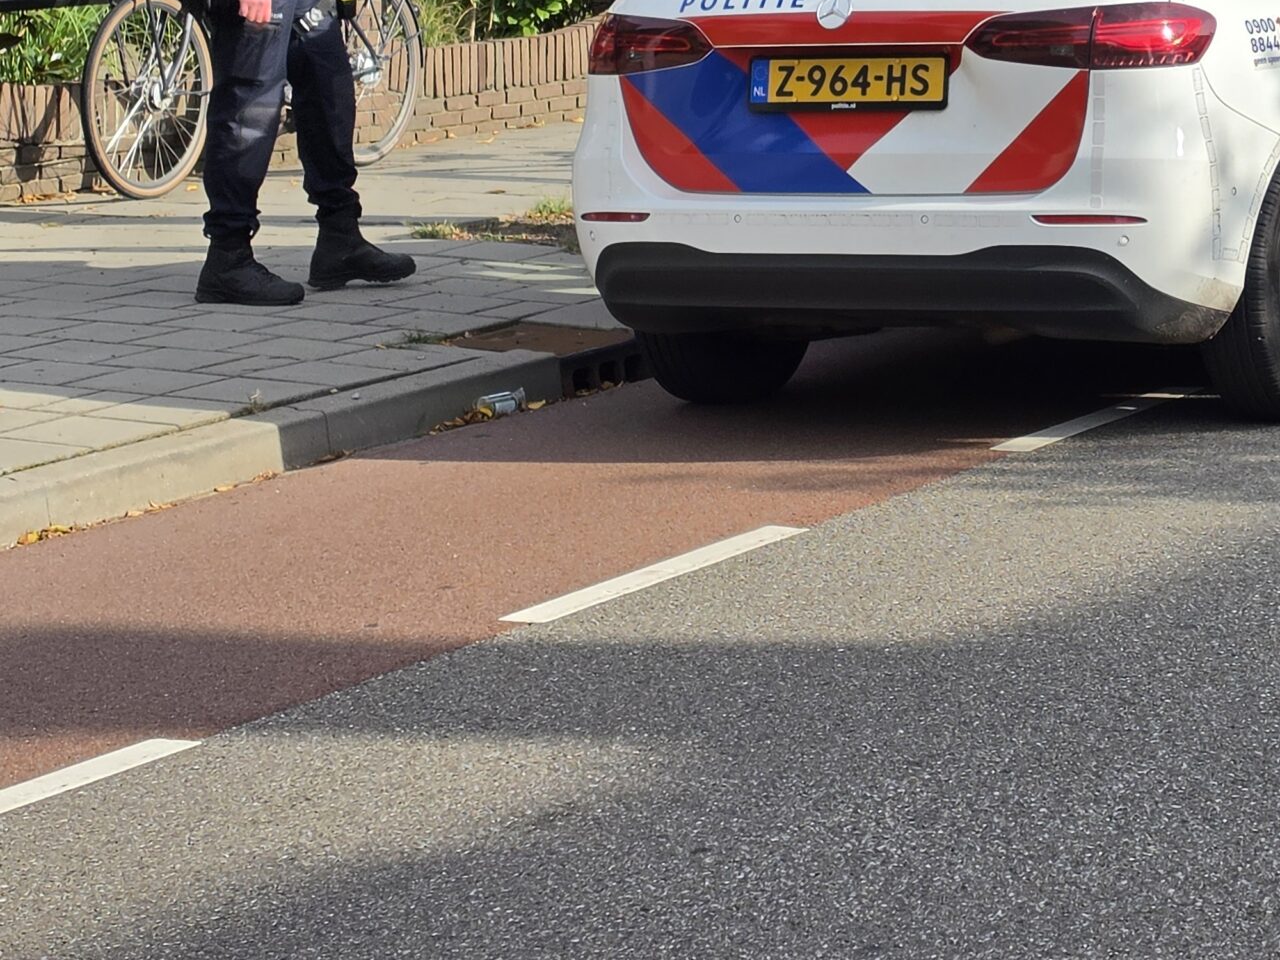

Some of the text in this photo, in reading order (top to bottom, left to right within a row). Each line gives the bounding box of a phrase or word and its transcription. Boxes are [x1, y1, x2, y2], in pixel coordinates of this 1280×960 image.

[1245, 17, 1276, 35] 0900
[1250, 35, 1280, 53] 8844
[775, 63, 930, 97] Z-964-HS
[753, 87, 766, 97] NL
